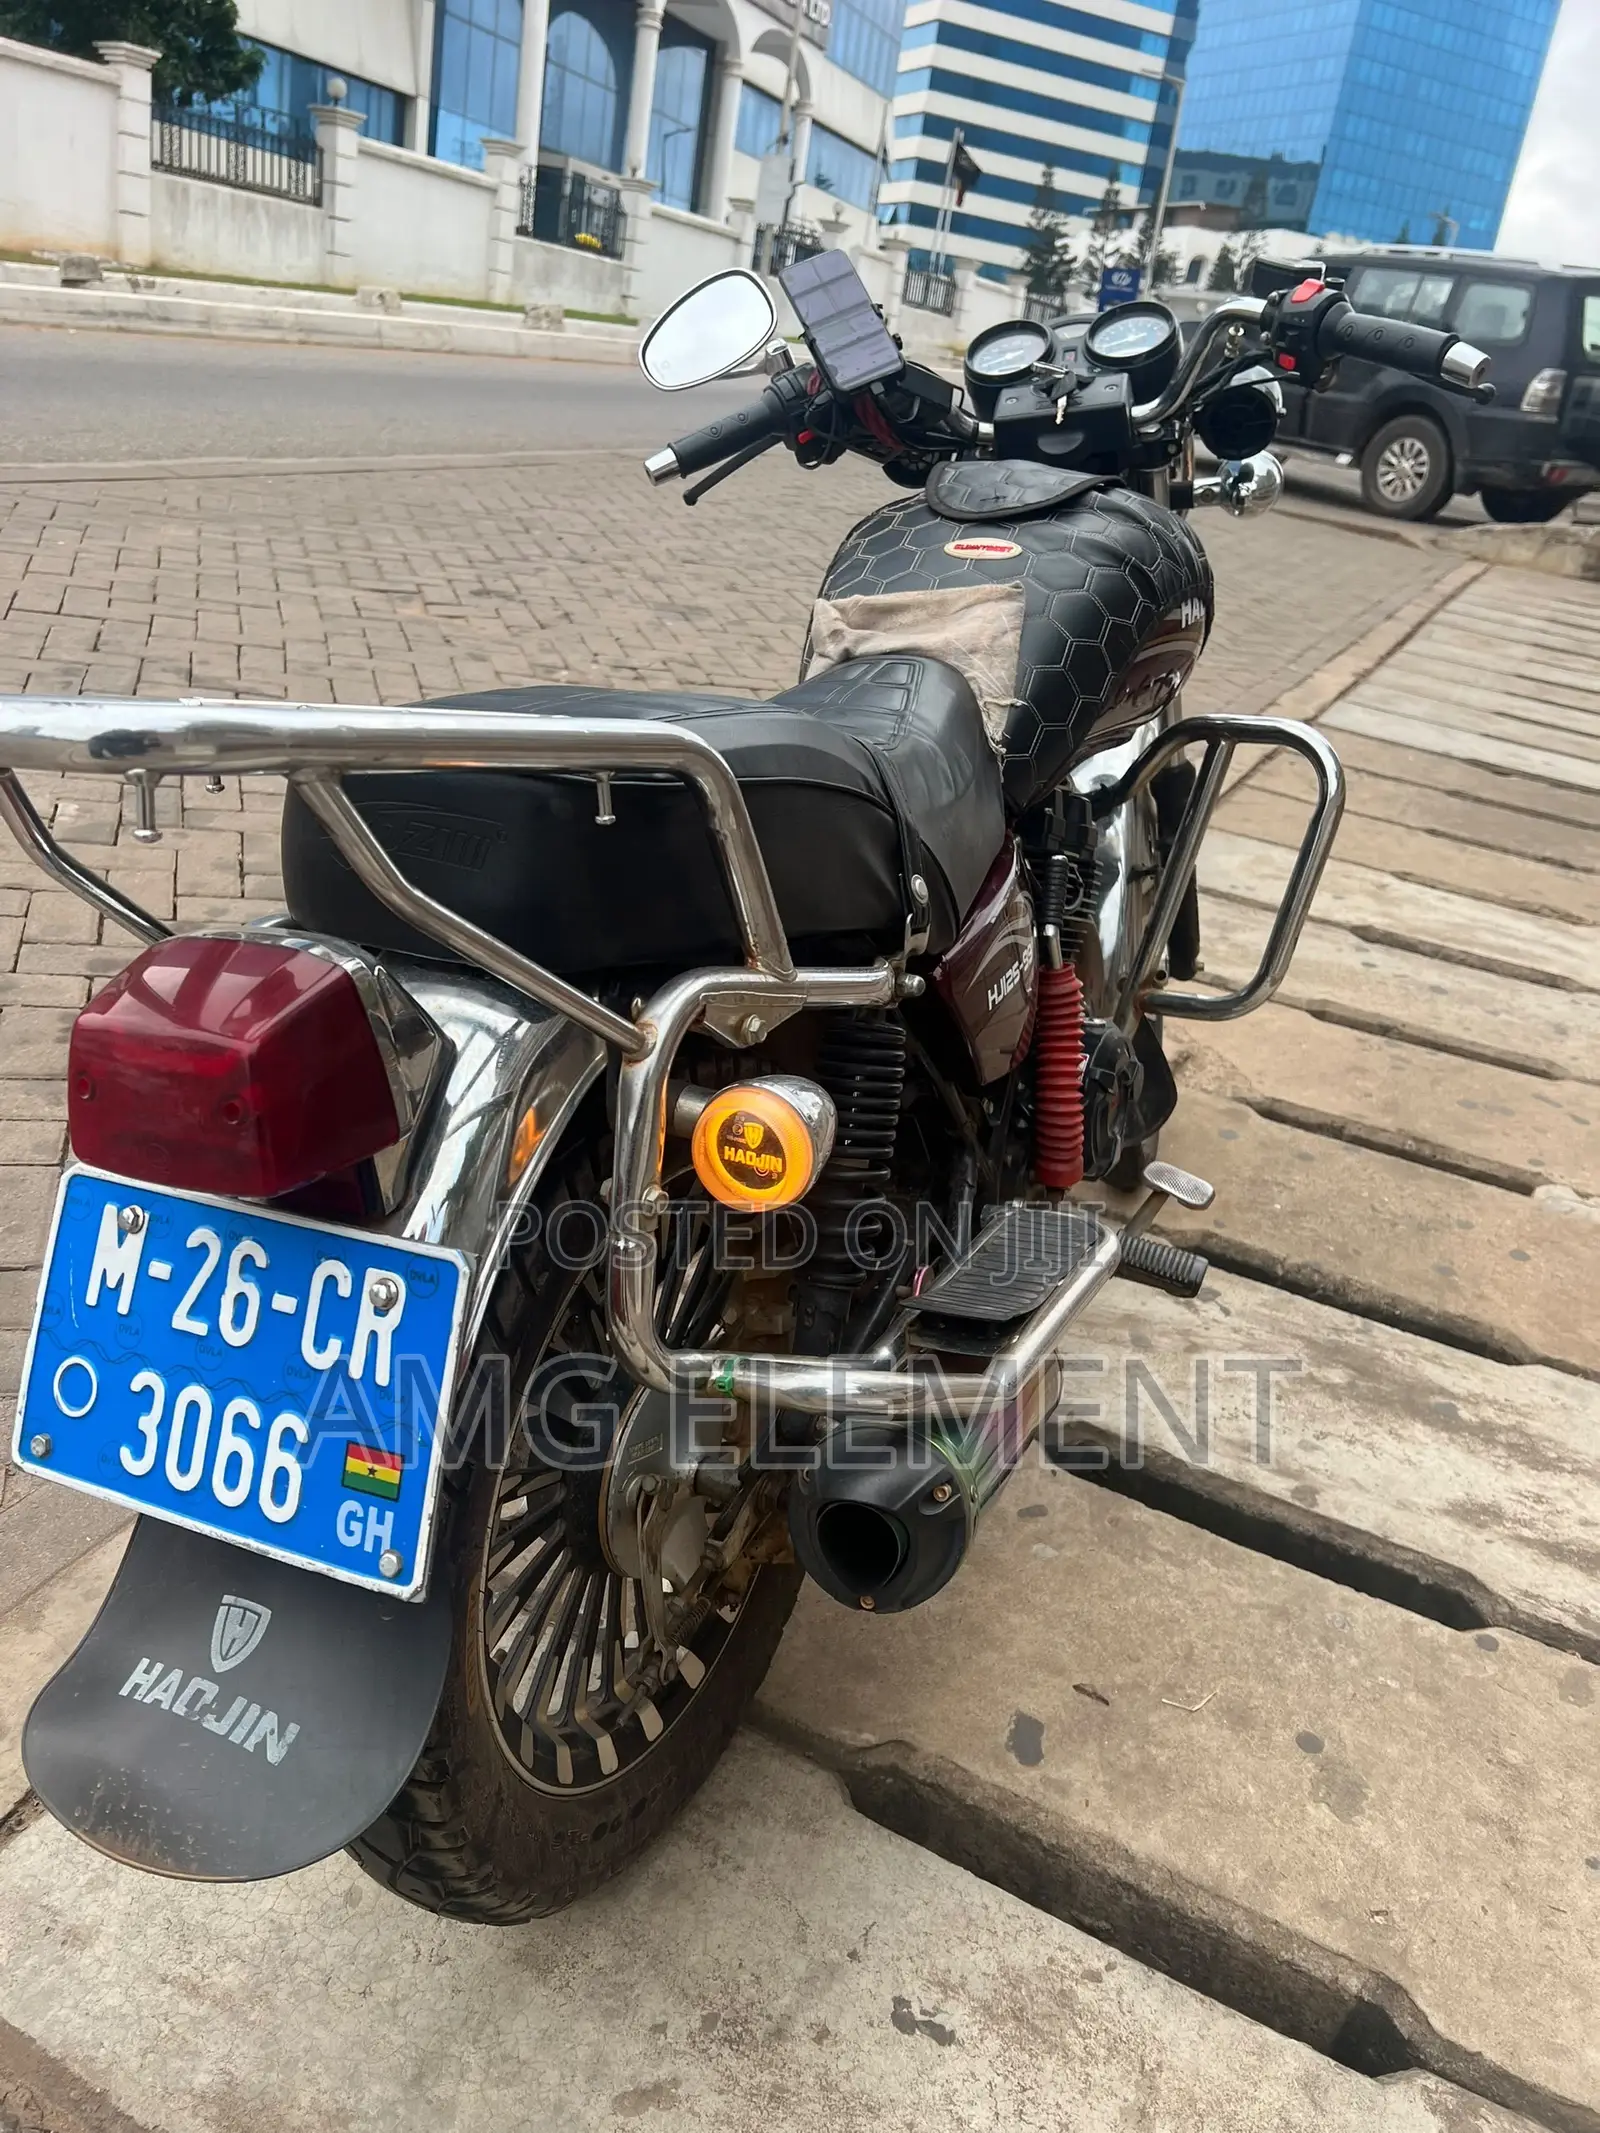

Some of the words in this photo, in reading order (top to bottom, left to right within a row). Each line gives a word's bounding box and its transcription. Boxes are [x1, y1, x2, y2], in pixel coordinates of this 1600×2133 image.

[85, 1202, 407, 1387] M-26-CR
[119, 1371, 309, 1523] 3066
[336, 1500, 395, 1555] GH
